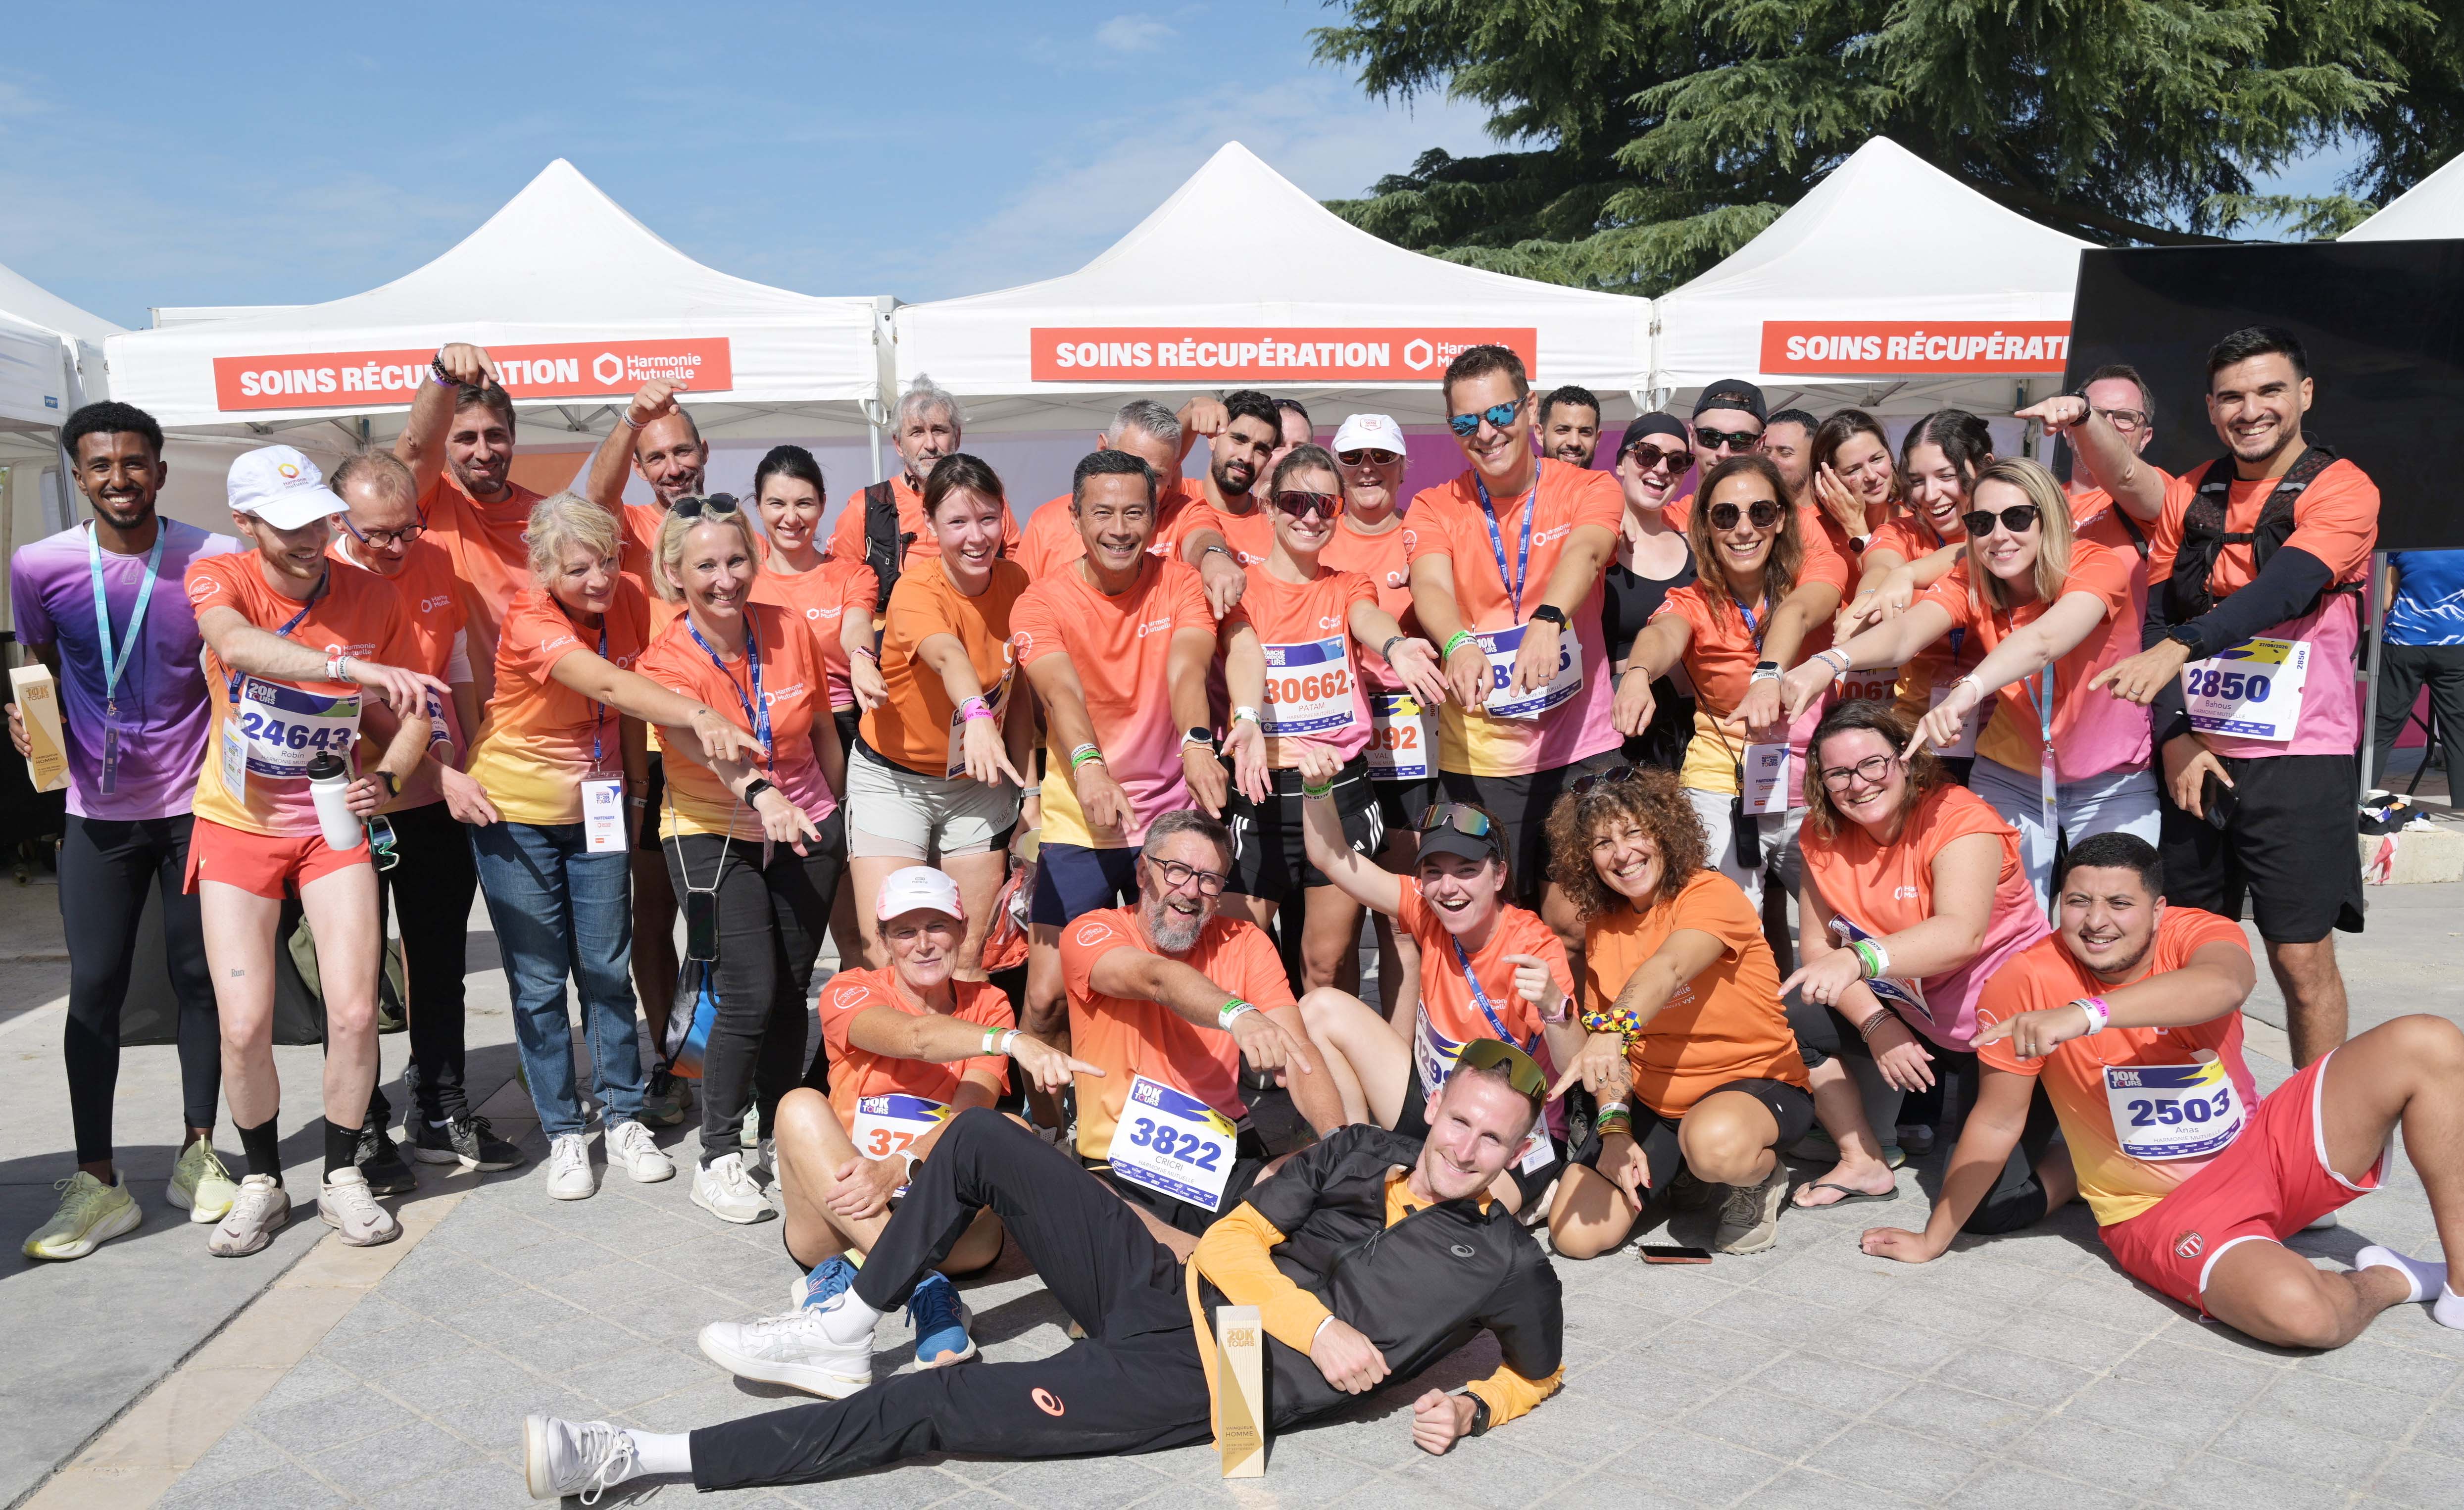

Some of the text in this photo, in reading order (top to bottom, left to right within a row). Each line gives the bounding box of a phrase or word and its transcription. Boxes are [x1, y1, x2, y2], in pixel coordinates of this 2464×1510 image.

[1056, 338, 1389, 367] SOINS RÉCUPÉRATION
[1786, 331, 2069, 360] SOINS RÉCUPÉRATI
[627, 353, 701, 368] Harmonie
[240, 358, 579, 396] SOINS RÉCUATION
[628, 366, 694, 381] Mutuelle
[623, 412, 636, 428] HARMO
[283, 477, 307, 487] Harmonie
[821, 605, 842, 613] Harmon
[1477, 637, 1496, 648] 10K
[344, 648, 372, 657] Mutuelle
[2297, 650, 2305, 670] 2850
[250, 682, 278, 696] 20K
[775, 682, 804, 695] Harmonie
[1263, 669, 1348, 704] 30662
[1511, 693, 1537, 702] HARMONIE
[1538, 683, 1563, 697] MUTUELLE
[2187, 668, 2271, 703] 2850
[248, 692, 276, 705] TOURS
[777, 689, 804, 702] Mutuelle
[1299, 702, 1325, 712] PATAM
[2205, 700, 2232, 710] Bahous
[2217, 711, 2246, 719] MUTUELLE
[243, 713, 351, 750] 24643
[1363, 726, 1417, 751] 092
[261, 755, 291, 765] HARMONIE
[281, 750, 305, 759] Robin
[992, 810, 1010, 828] TRAIL
[231, 968, 245, 977] Run
[1672, 985, 1691, 999] uelle
[1682, 994, 1695, 1005] vyv
[1417, 1032, 1450, 1084] 129
[2110, 1071, 2140, 1082] 10K
[1137, 1083, 1163, 1101] 10K
[863, 1096, 889, 1109] 10K
[1135, 1093, 1160, 1107] TOURS
[2127, 1088, 2230, 1126] 2503
[862, 1106, 889, 1115] TOURS
[1599, 1104, 1611, 1113] UELLE
[2154, 1128, 2221, 1144] HARMONIE MUTUELLE
[1130, 1117, 1222, 1172] 3822
[1155, 1156, 1183, 1172] CRICRI
[1138, 1159, 1195, 1184] HARMONIE MUTUELLE
[1227, 1330, 1255, 1341] 20K
